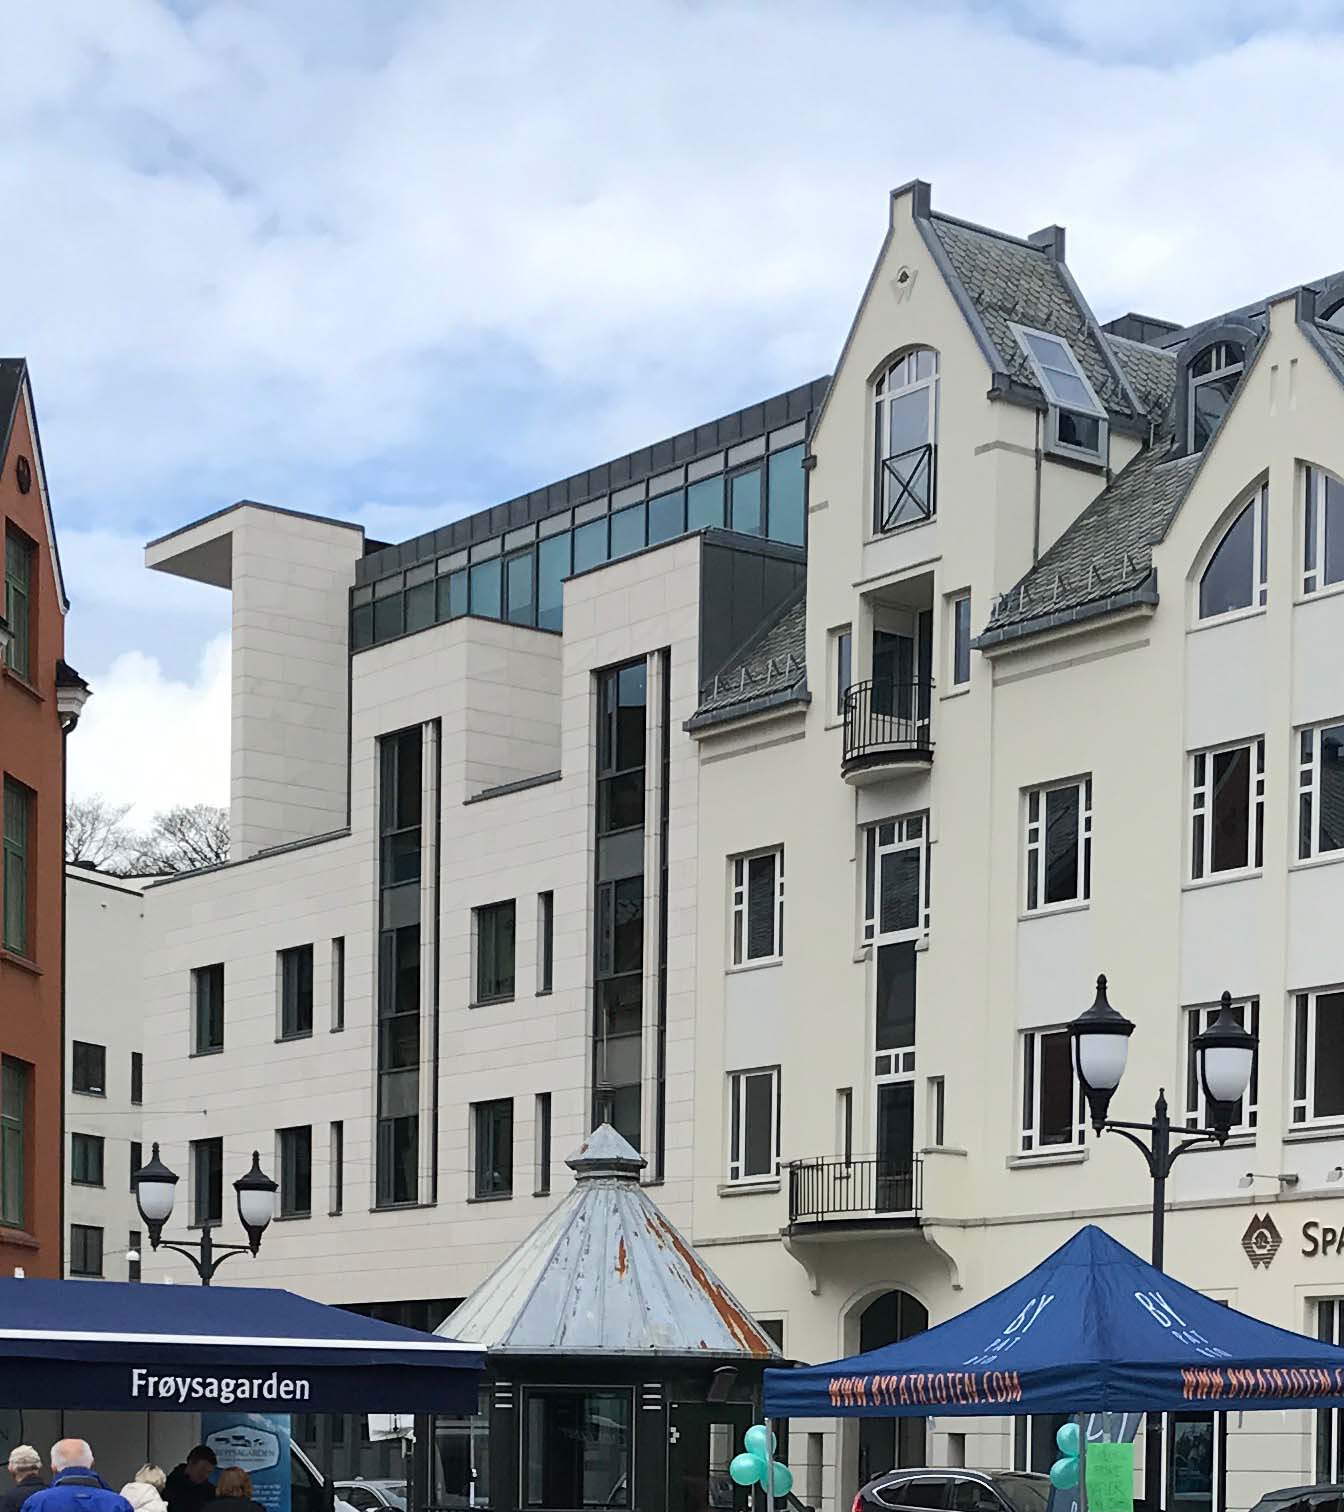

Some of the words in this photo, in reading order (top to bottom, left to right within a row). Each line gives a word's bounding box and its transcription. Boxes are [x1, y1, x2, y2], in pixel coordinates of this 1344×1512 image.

[1003, 1294, 1055, 1335] BY
[1134, 1291, 1187, 1328] BY
[132, 1369, 310, 1404] Frøysagarden
[828, 1371, 1023, 1407] WWW.BYPATRIOTEN.COM
